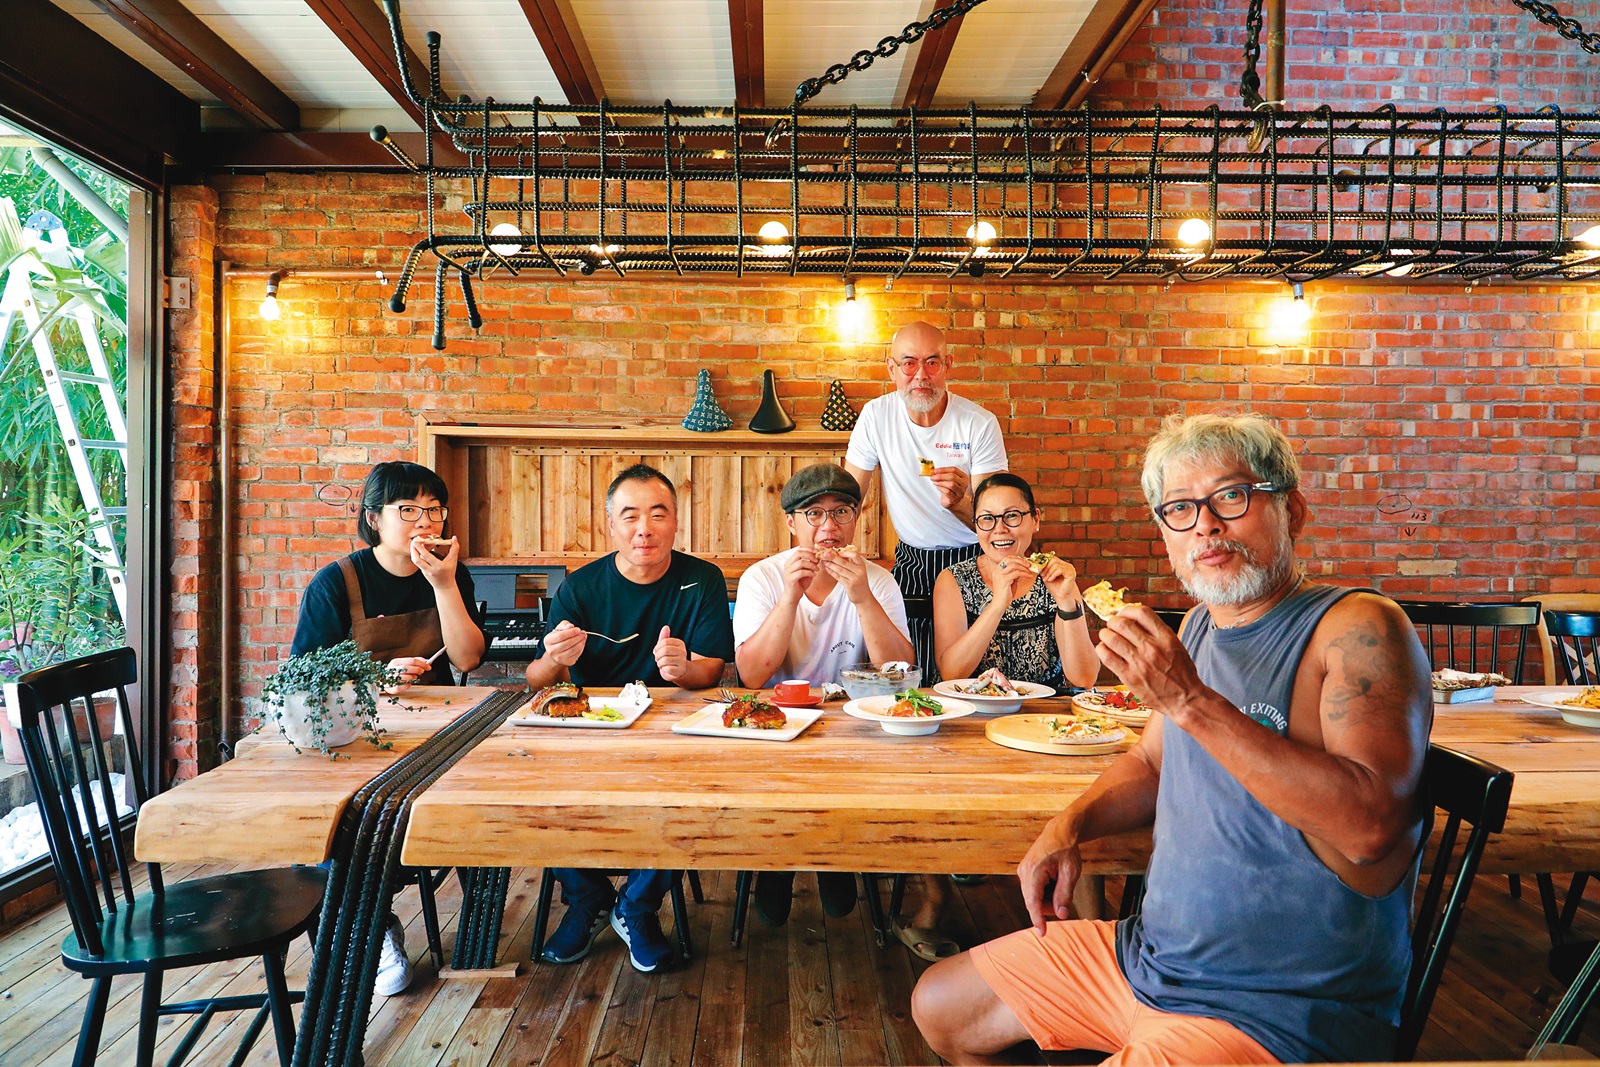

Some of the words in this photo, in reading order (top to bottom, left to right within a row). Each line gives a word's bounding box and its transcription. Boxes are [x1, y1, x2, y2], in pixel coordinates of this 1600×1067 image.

[1410, 512, 1427, 521] 113
[830, 641, 843, 654] ABOUT
[1250, 702, 1288, 731] EXITING
